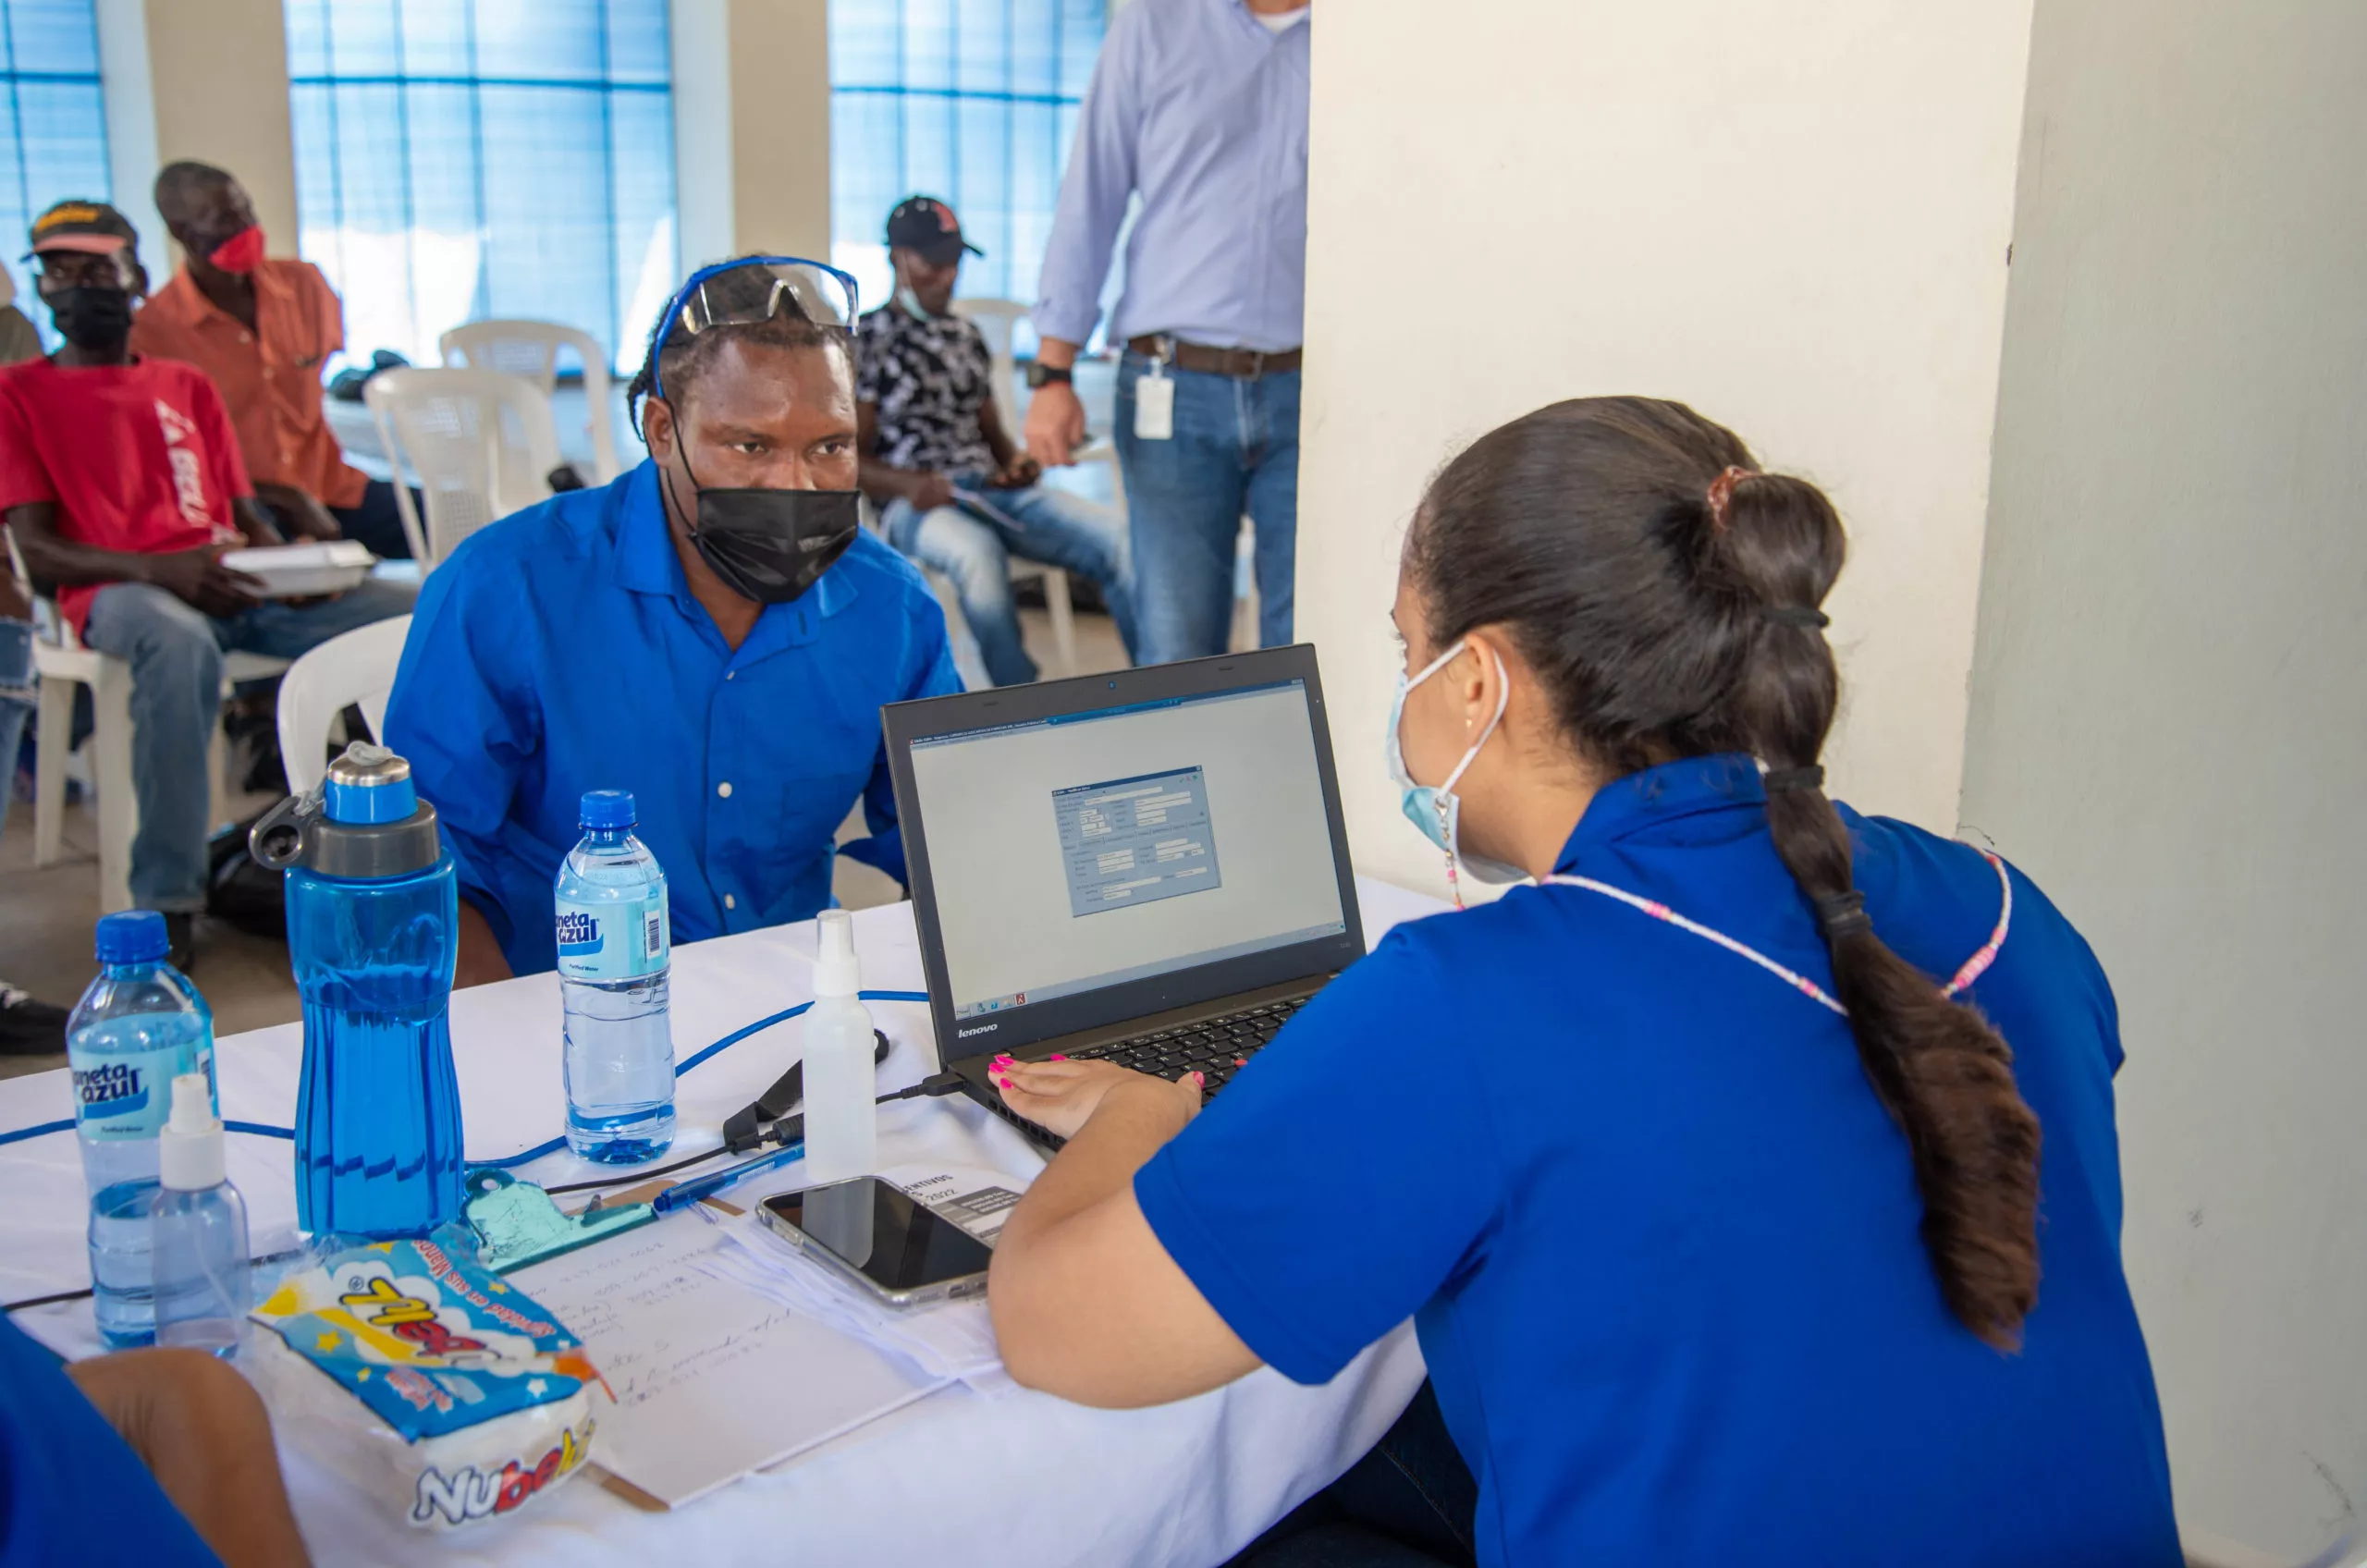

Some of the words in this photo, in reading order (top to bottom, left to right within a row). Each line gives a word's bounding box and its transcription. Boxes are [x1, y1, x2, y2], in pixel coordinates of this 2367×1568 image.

[558, 918, 597, 943] azul
[958, 1023, 998, 1039] lenovo
[81, 1069, 139, 1104] azul
[904, 1174, 953, 1192] ENTIVOS
[444, 1270, 471, 1294] sus
[466, 1291, 489, 1307] en
